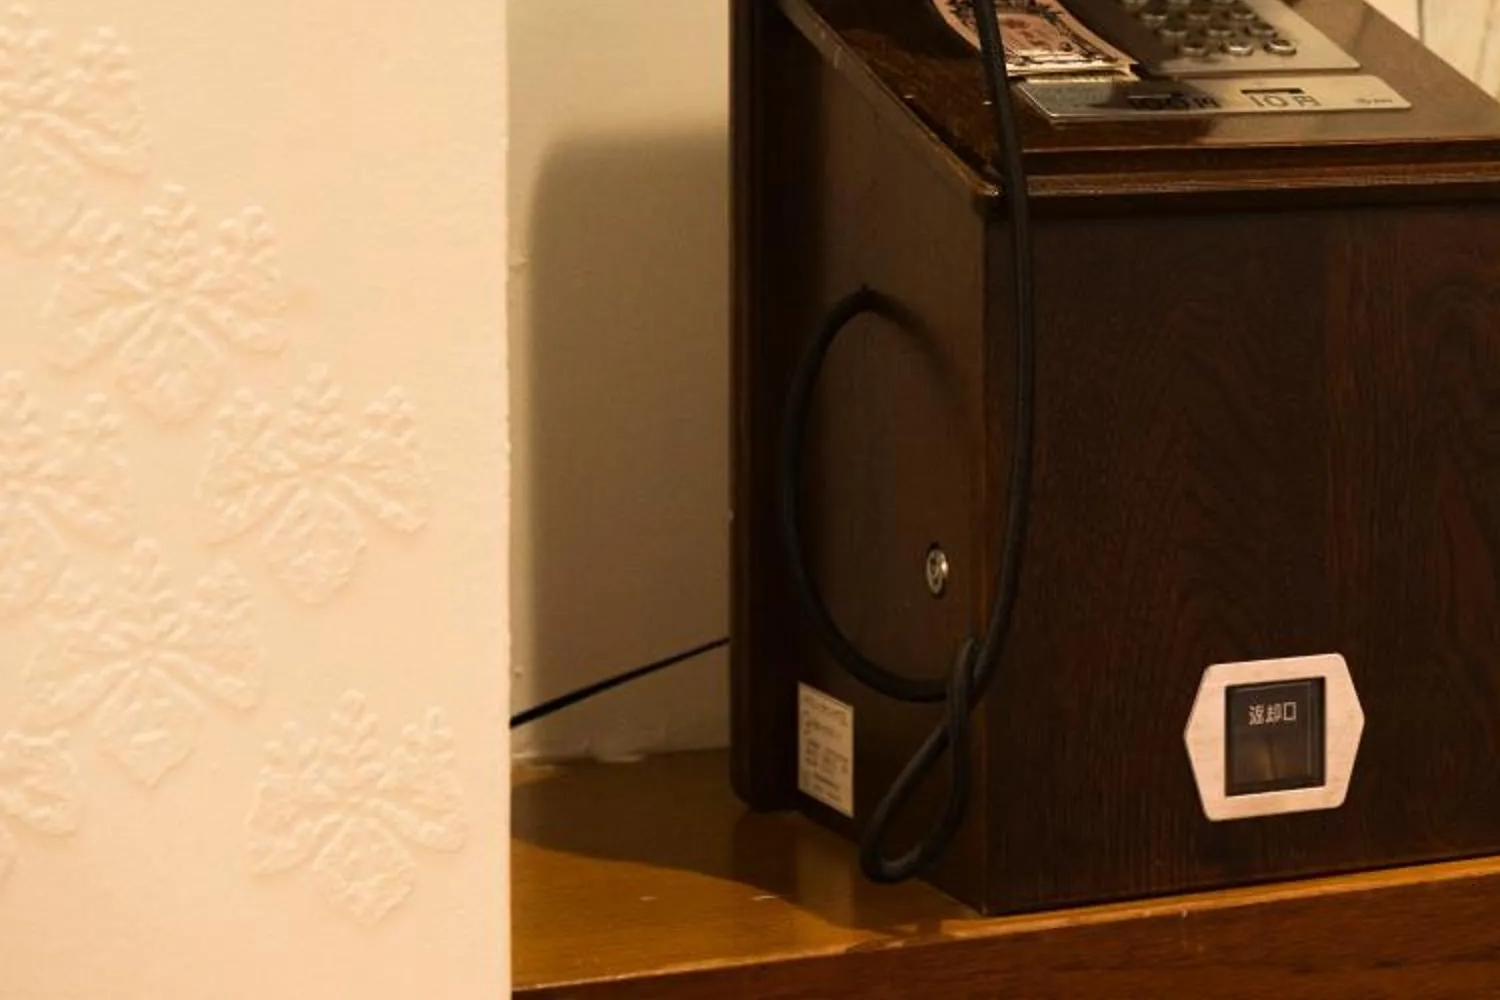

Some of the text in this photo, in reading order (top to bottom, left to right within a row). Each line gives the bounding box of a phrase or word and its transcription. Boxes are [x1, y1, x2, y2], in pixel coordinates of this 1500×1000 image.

[1249, 94, 1322, 108] 10円
[1248, 701, 1297, 727] 返却口
